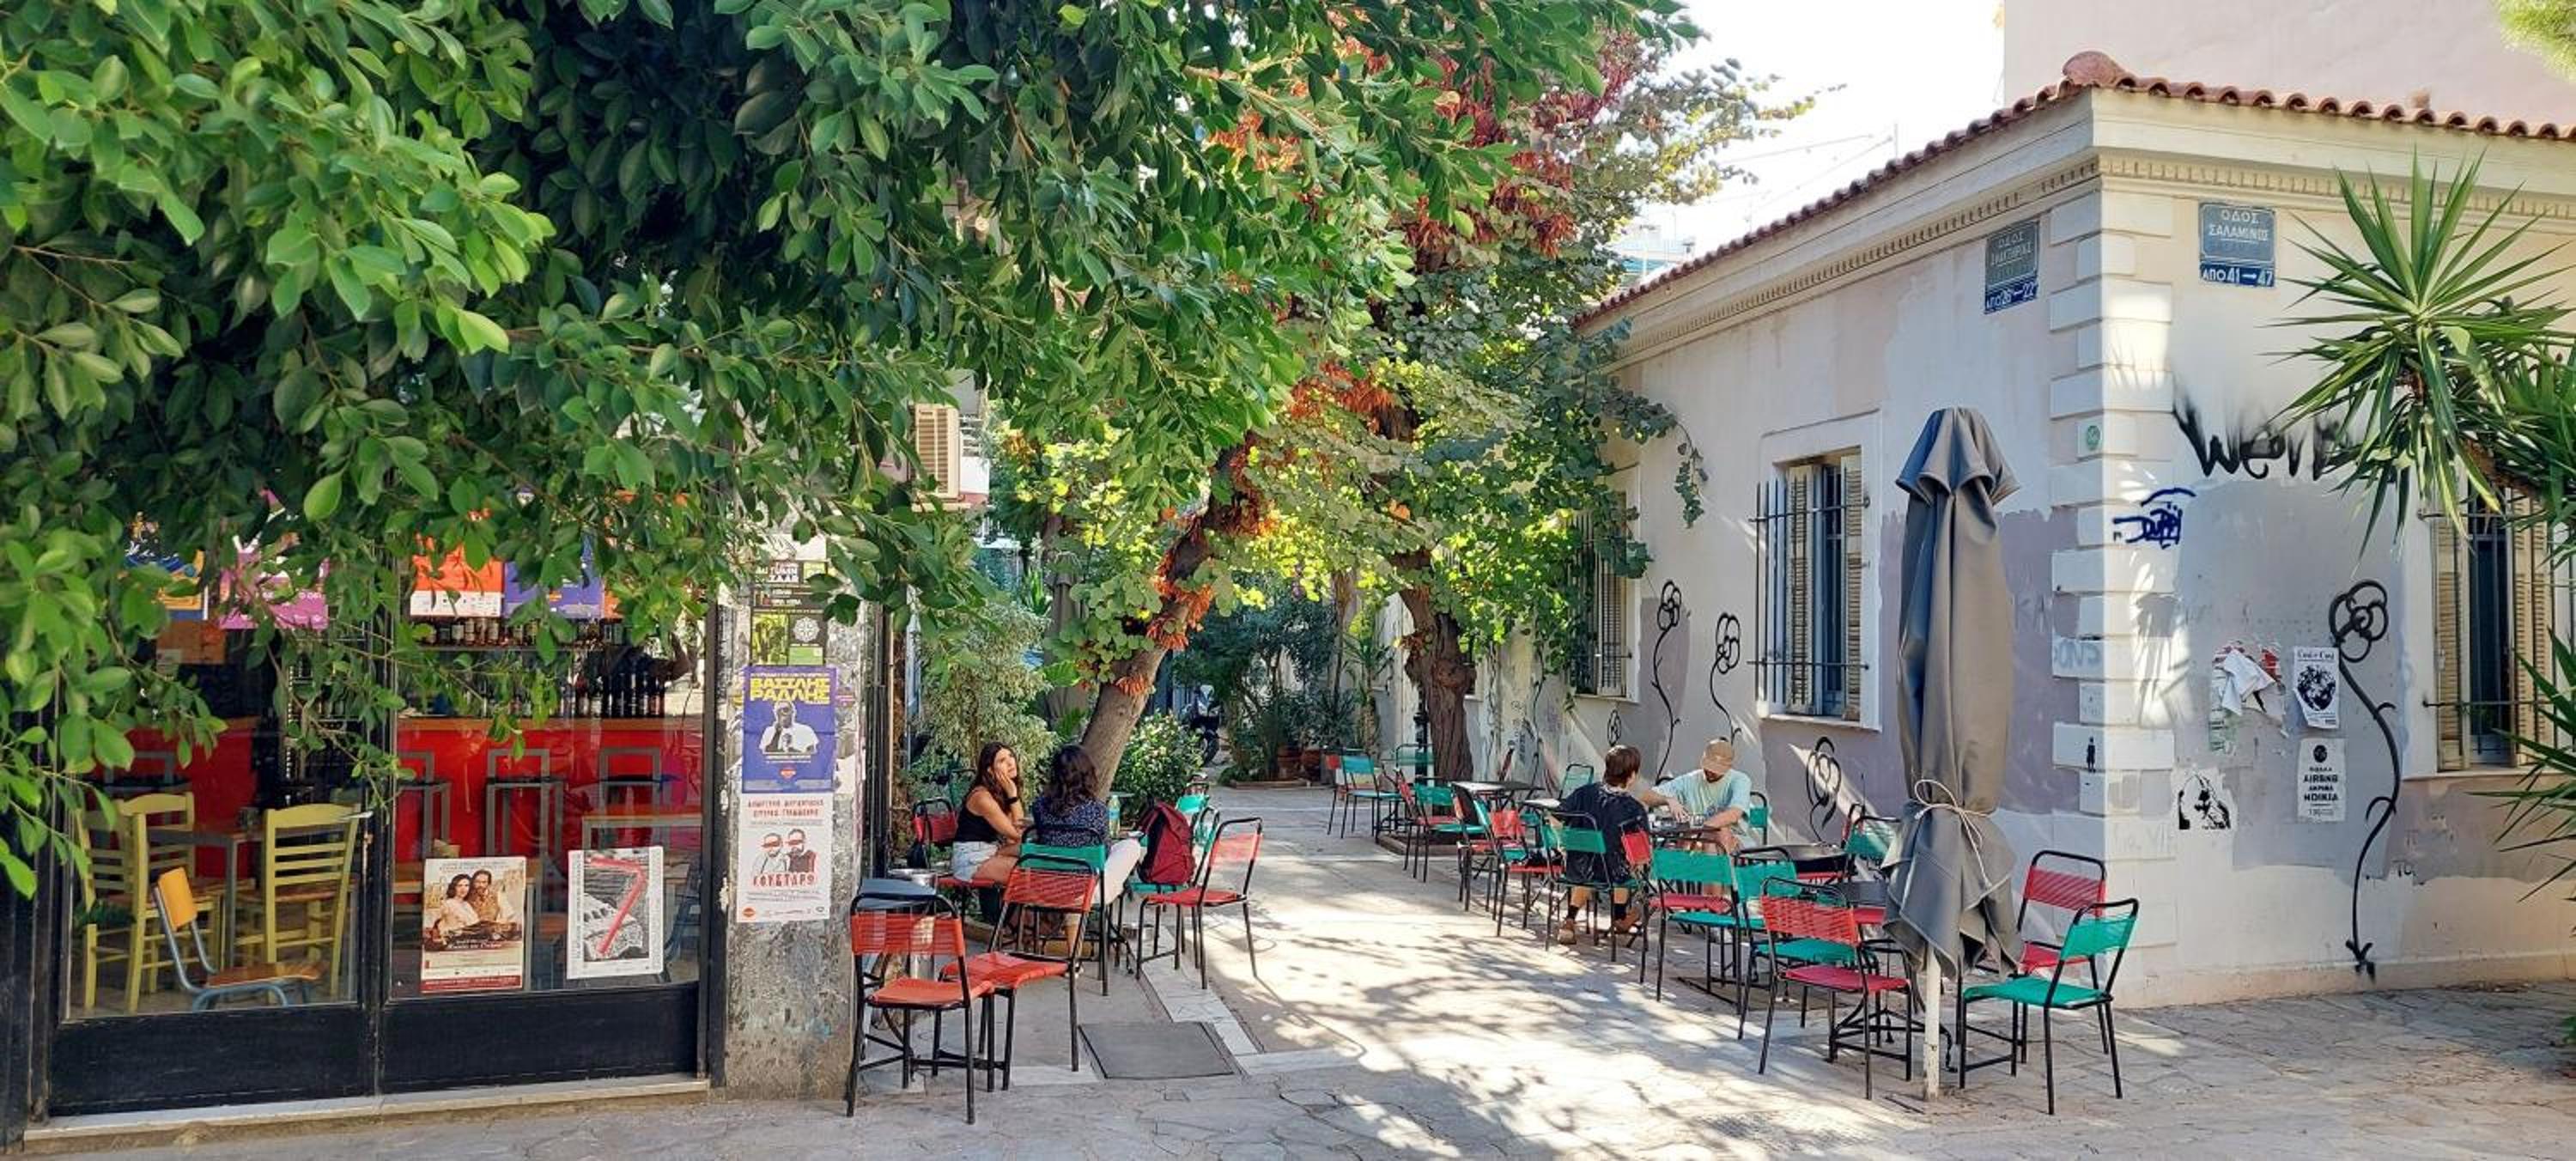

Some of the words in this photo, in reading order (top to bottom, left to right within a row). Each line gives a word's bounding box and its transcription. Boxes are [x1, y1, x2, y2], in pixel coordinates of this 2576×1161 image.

[2221, 209, 2259, 224] ΟΔΟΣ
[2202, 268, 2227, 281] ΑΠΟ
[2227, 267, 2240, 283] 41
[2257, 270, 2273, 285] 47
